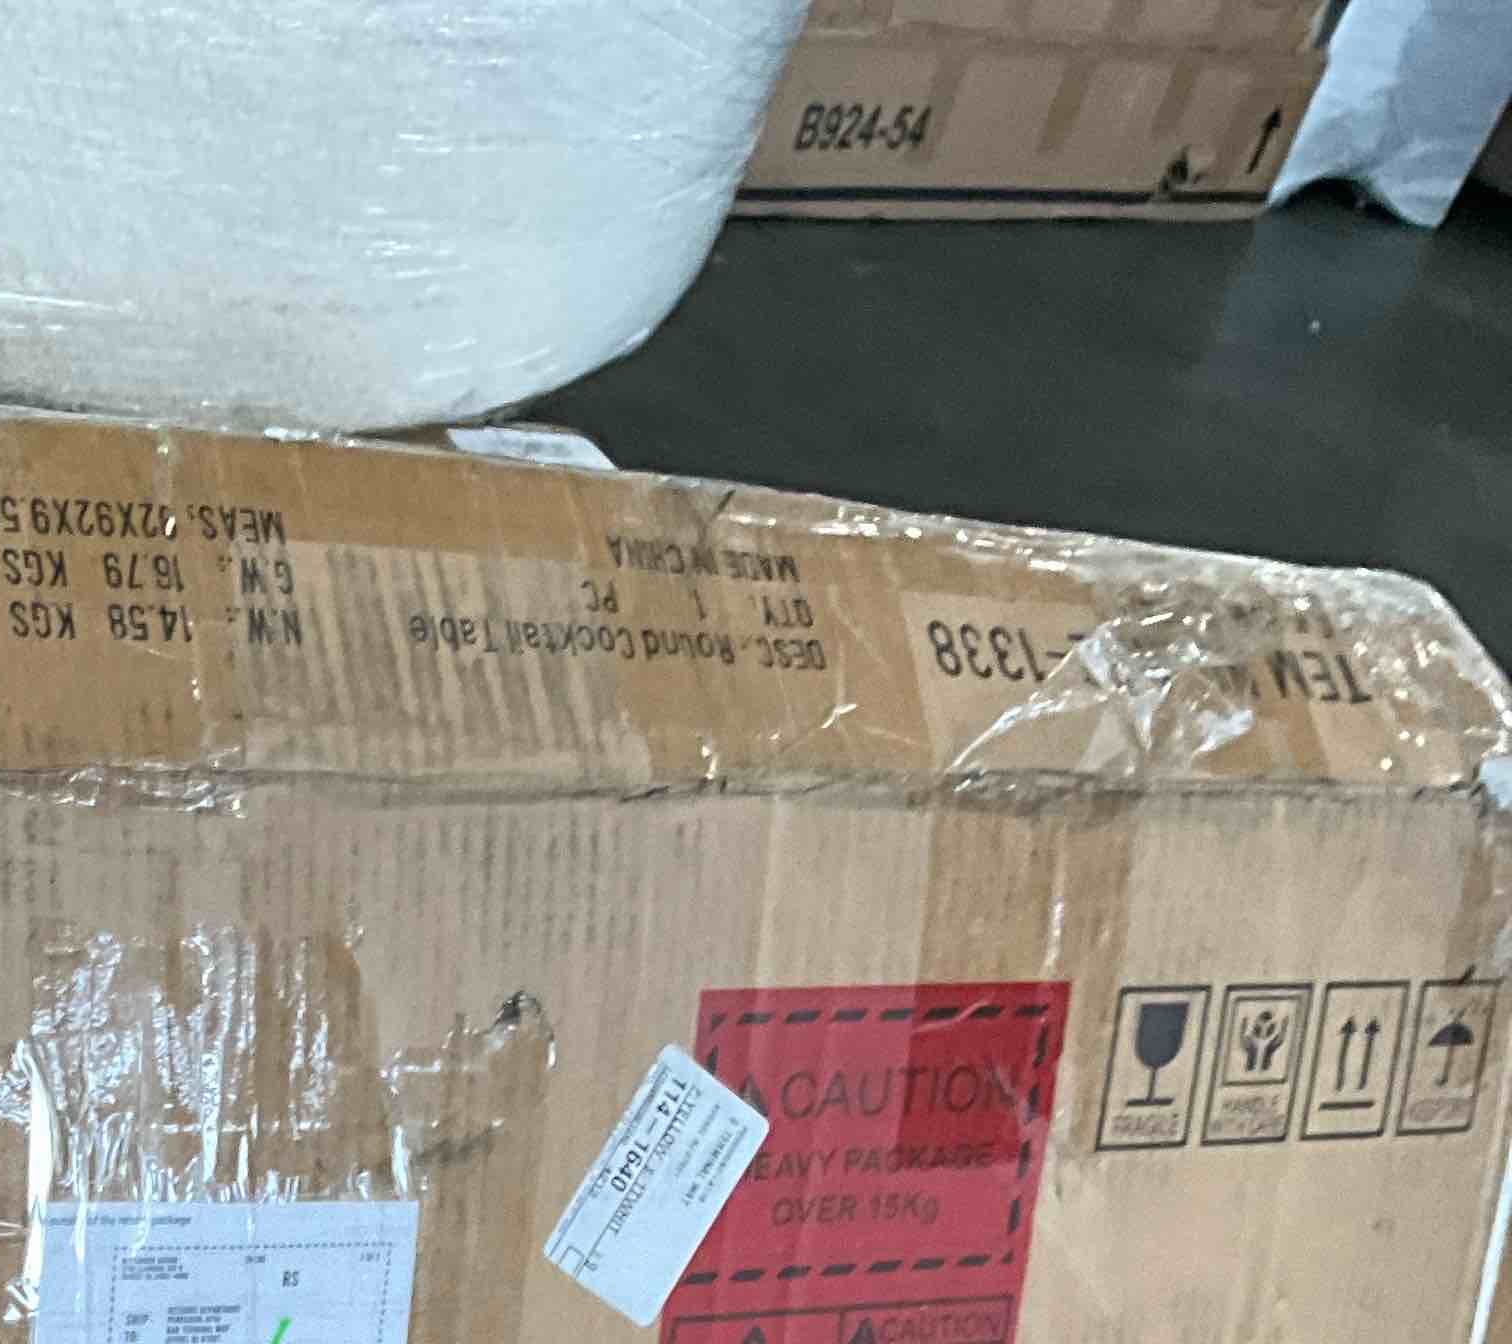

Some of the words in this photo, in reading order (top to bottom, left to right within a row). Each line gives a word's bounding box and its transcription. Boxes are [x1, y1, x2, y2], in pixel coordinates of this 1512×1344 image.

[794, 104, 933, 152] B924-54
[2, 549, 68, 587] KGS
[103, 552, 185, 592] 16.79
[580, 580, 619, 615] PC
[9, 601, 76, 640] KGS
[108, 603, 193, 642] 14.58
[409, 614, 500, 655] Table
[505, 618, 636, 660] Cocktail
[641, 629, 736, 665] Round
[656, 1076, 688, 1117] 114
[782, 1065, 1020, 1119] CAUTION
[609, 1138, 650, 1193] 1640
[844, 1142, 996, 1174] PACKAGE
[772, 1193, 858, 1227] OVER
[282, 1270, 299, 1288] RS
